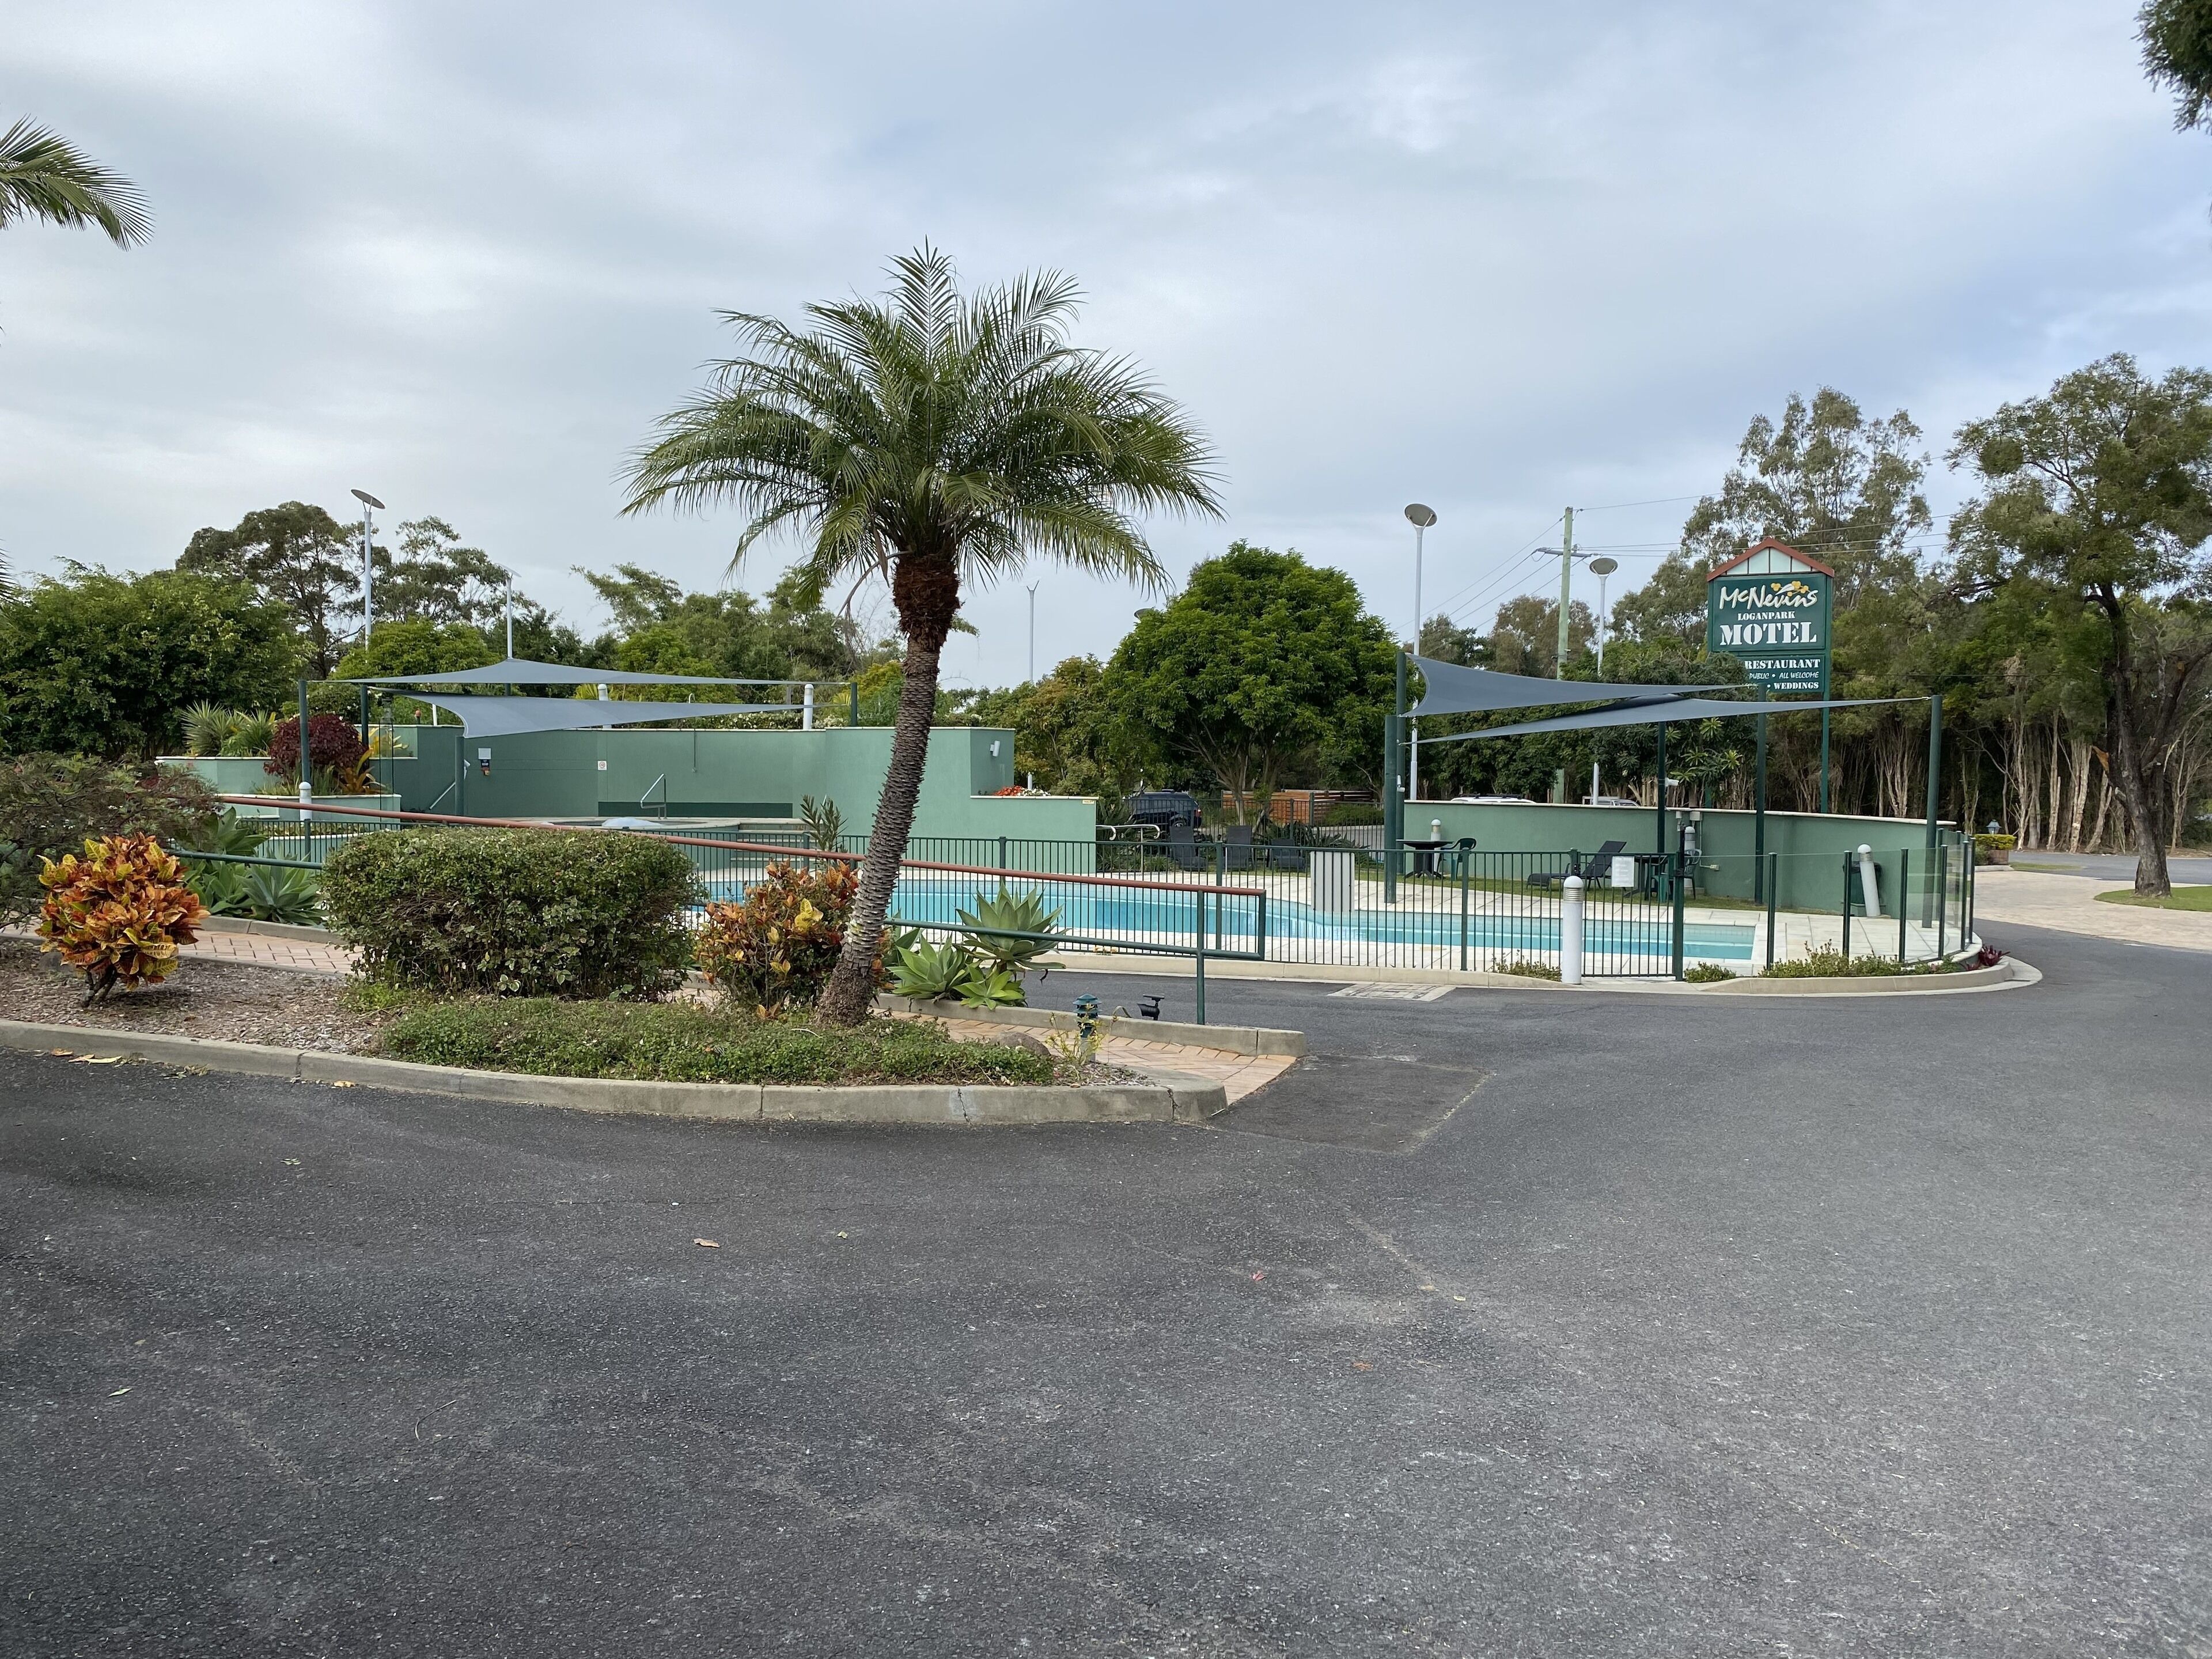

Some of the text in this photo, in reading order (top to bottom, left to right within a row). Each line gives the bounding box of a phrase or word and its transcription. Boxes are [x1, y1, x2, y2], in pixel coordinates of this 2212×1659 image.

[1719, 585, 1819, 609] McNevins
[1737, 611, 1796, 621] LOGANPARK
[1719, 622, 1817, 646] MOTEL
[1744, 659, 1821, 669] RESTAURANT
[1774, 681, 1819, 690] WEDDINGS
